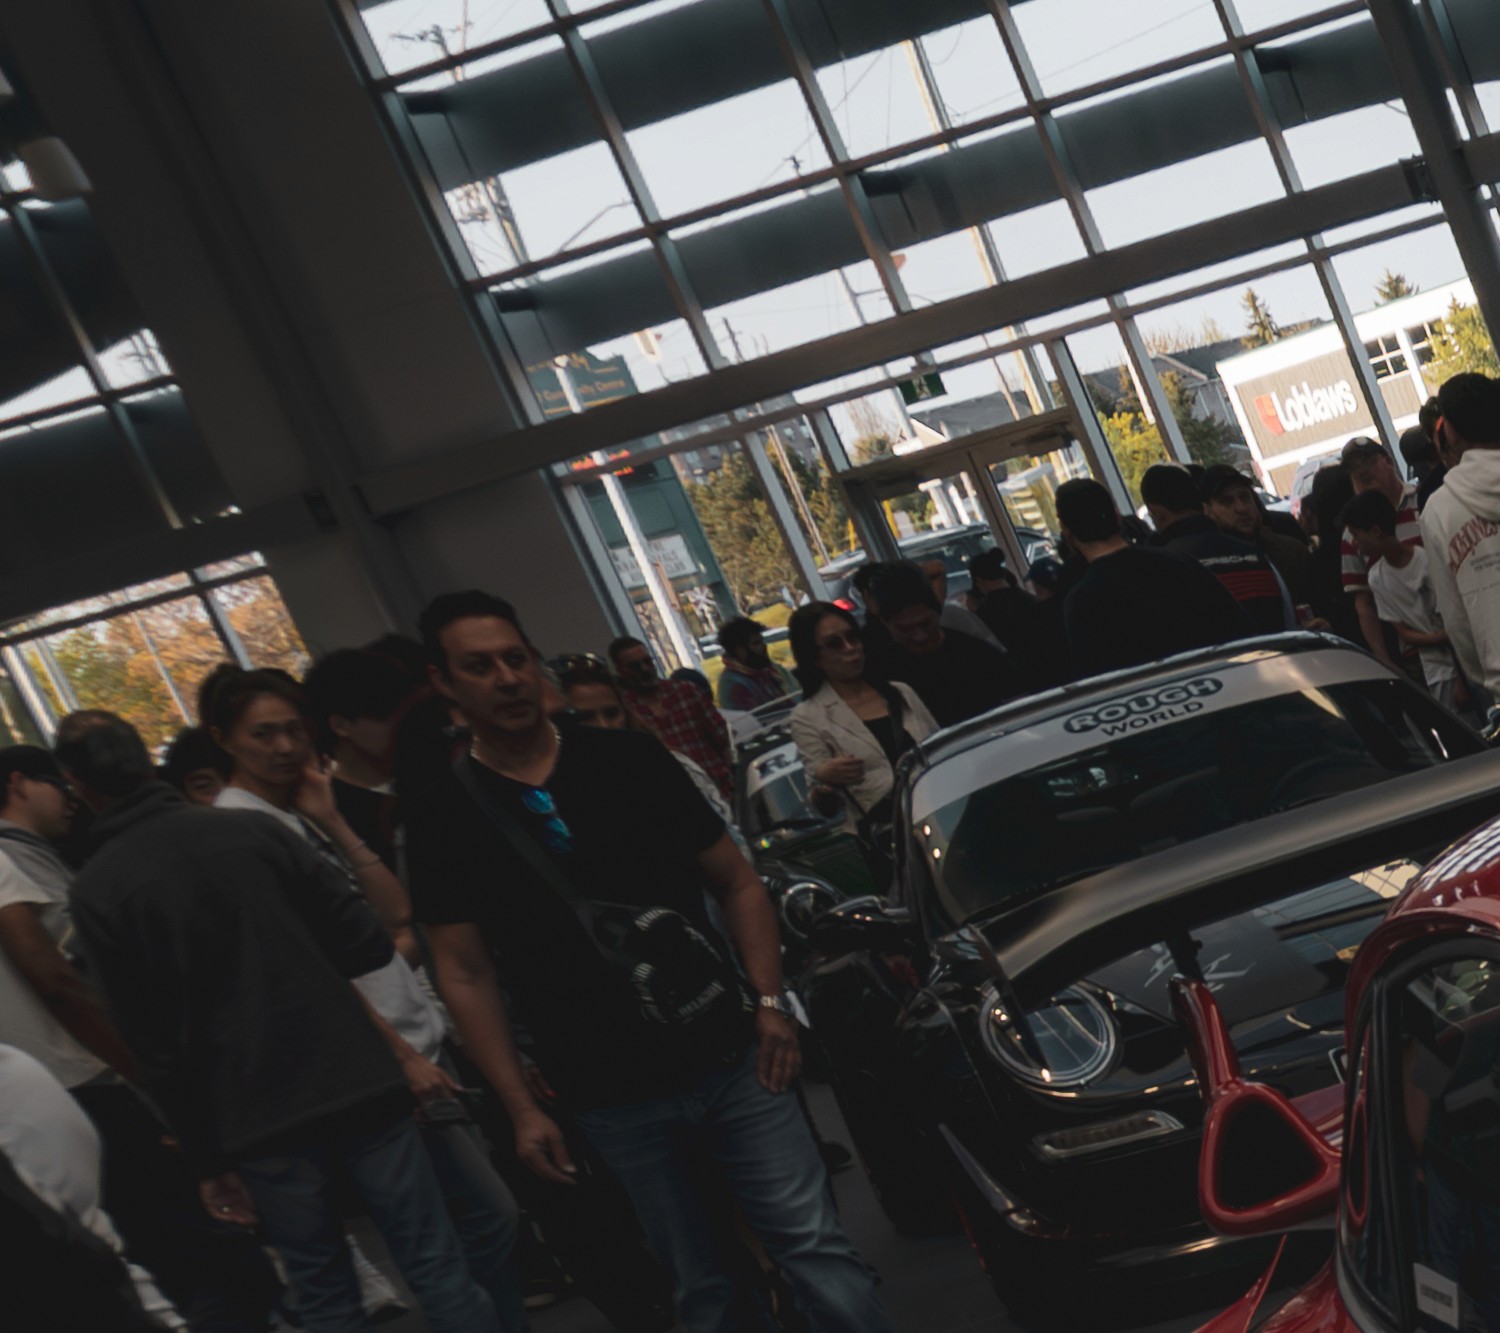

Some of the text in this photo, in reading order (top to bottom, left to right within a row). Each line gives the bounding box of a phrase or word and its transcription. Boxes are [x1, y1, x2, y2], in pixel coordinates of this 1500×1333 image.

[1270, 378, 1358, 433] Loblaws
[1065, 678, 1222, 733] ROUGH
[1102, 701, 1203, 736] WORLD
